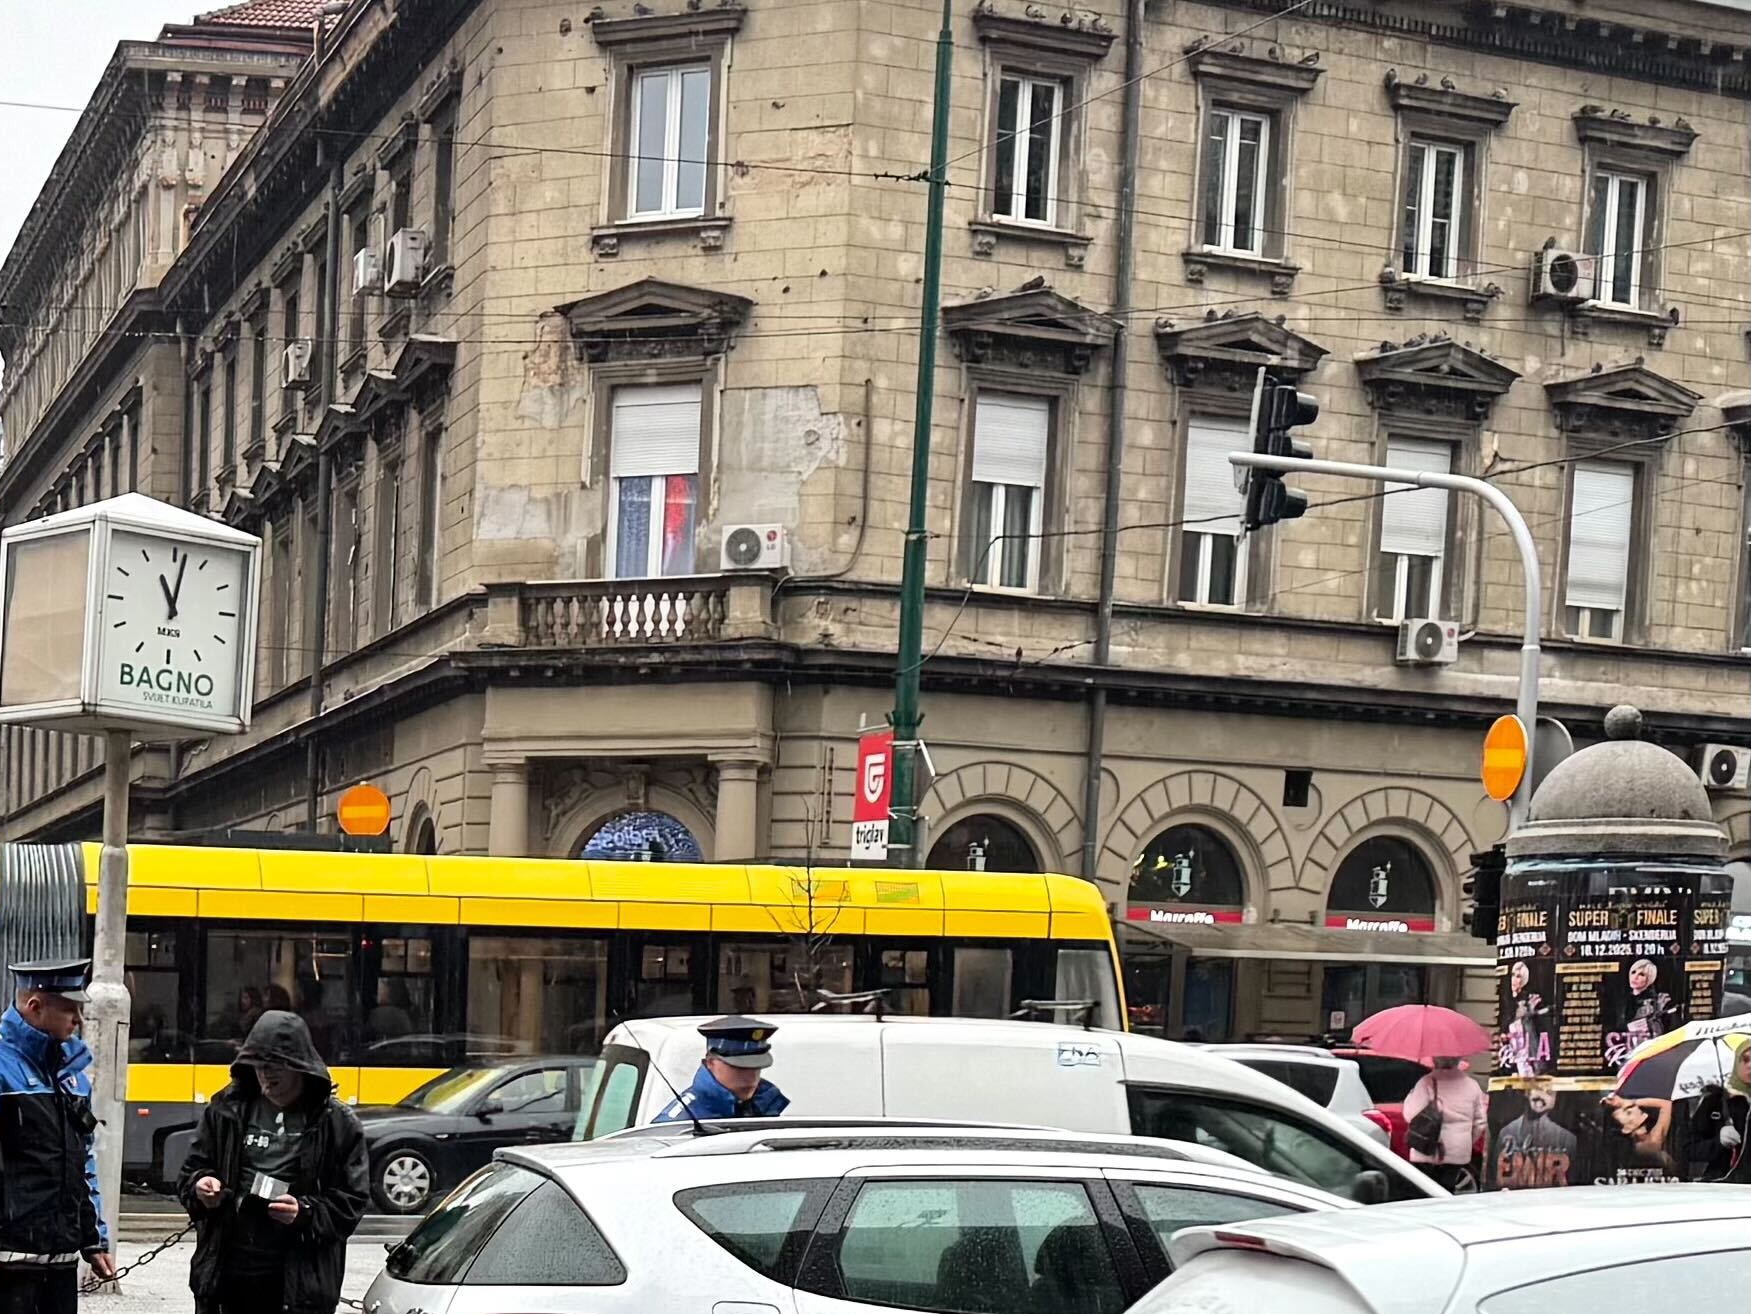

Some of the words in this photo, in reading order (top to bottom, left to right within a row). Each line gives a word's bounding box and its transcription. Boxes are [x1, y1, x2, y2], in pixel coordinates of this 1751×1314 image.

[119, 663, 214, 696] BAGNO
[856, 824, 884, 850] triglav
[1568, 910, 1609, 927] SUPER
[1636, 909, 1678, 926] FINALE
